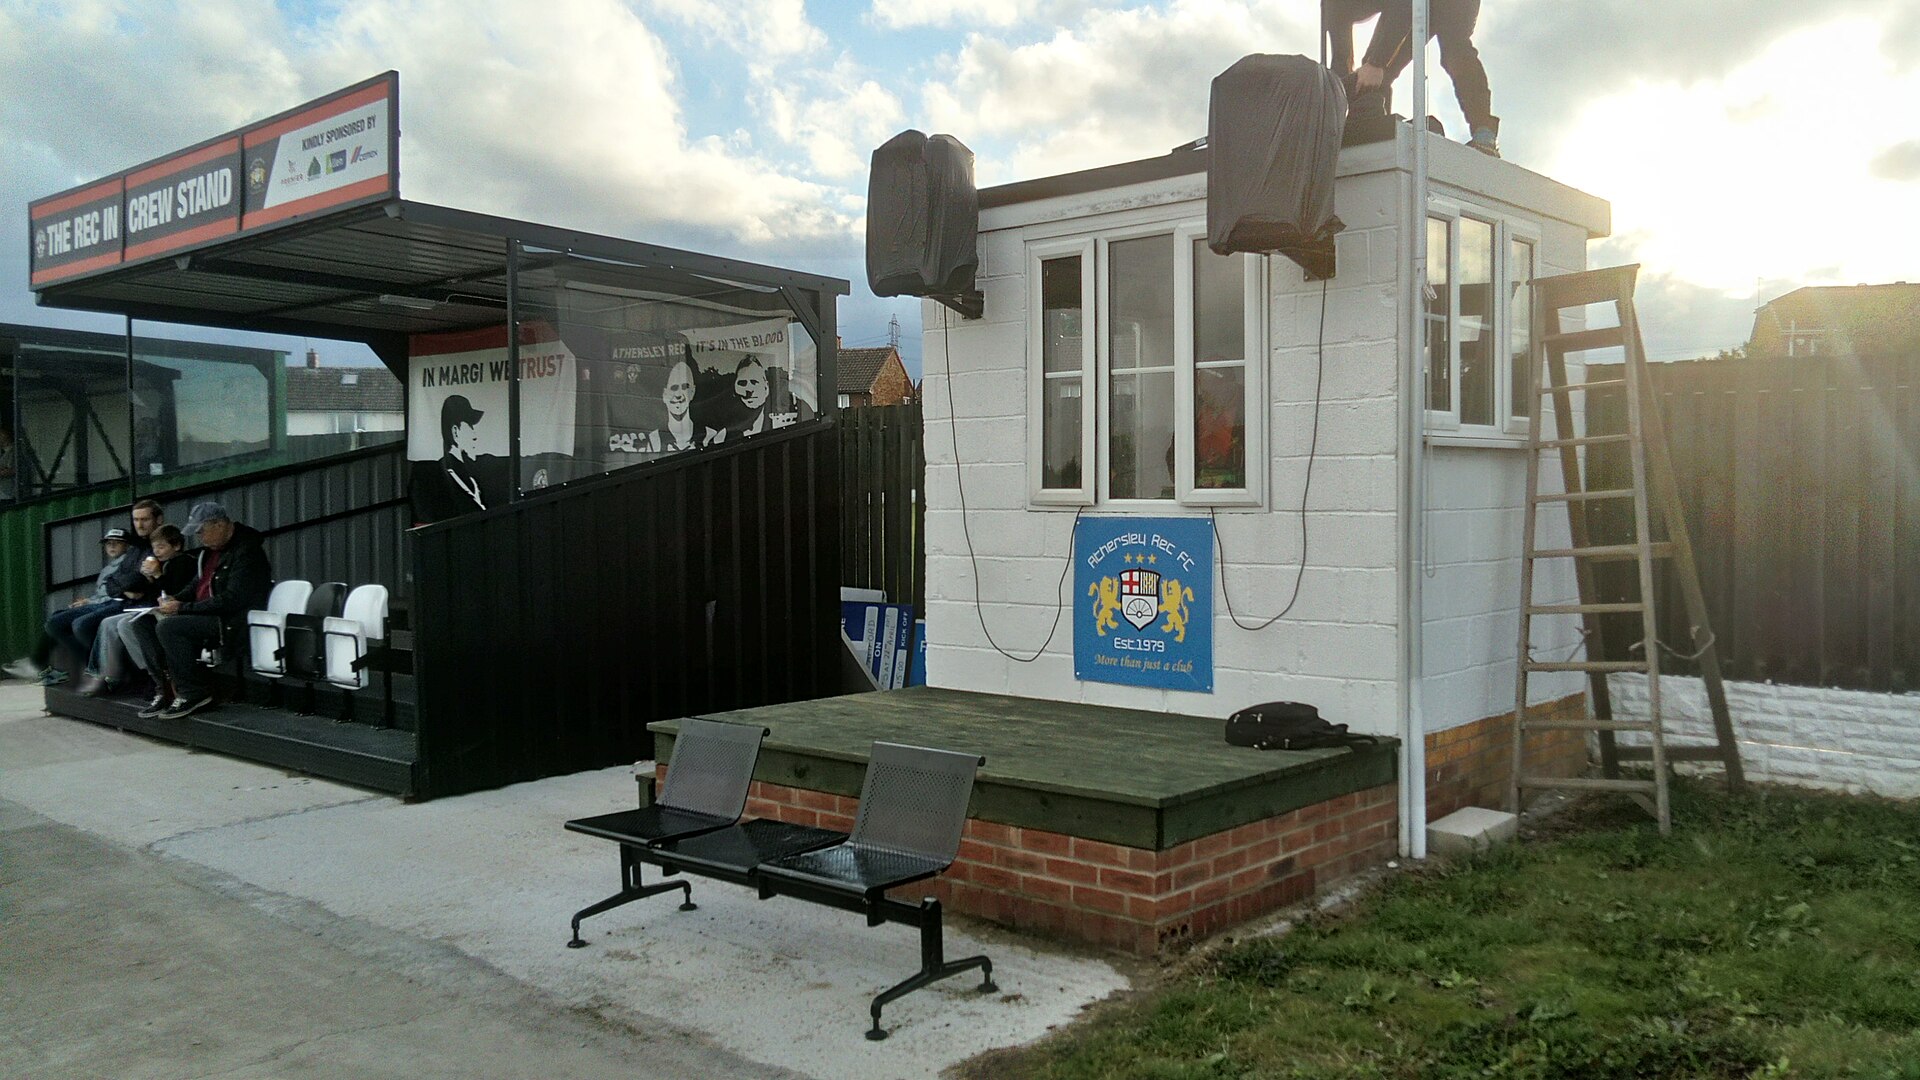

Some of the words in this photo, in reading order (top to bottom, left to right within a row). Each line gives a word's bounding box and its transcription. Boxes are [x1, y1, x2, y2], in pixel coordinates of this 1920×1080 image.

[302, 133, 325, 151] KINDLY
[326, 119, 365, 144] SPONSORED
[366, 114, 377, 130] BY
[46, 220, 71, 256] THE
[74, 211, 100, 250] REC
[103, 205, 118, 241] IN
[128, 186, 173, 234] CREW
[176, 167, 232, 219] STAND
[612, 345, 665, 360] ATHERSLEY
[668, 343, 686, 355] REC
[718, 339, 729, 351] IN
[730, 337, 750, 350] THE
[752, 330, 784, 347] BLOOD
[422, 367, 435, 387] IN
[438, 362, 484, 387] MARGI
[518, 354, 565, 380] TRUST
[1087, 532, 1146, 569] Athersley
[1150, 533, 1176, 555] Rec
[1176, 550, 1195, 573] FC
[875, 641, 882, 657] ON
[1094, 654, 1119, 666] More
[1120, 655, 1142, 668] than
[1141, 658, 1161, 673] just
[1163, 662, 1171, 671] a
[1172, 660, 1193, 673] club
